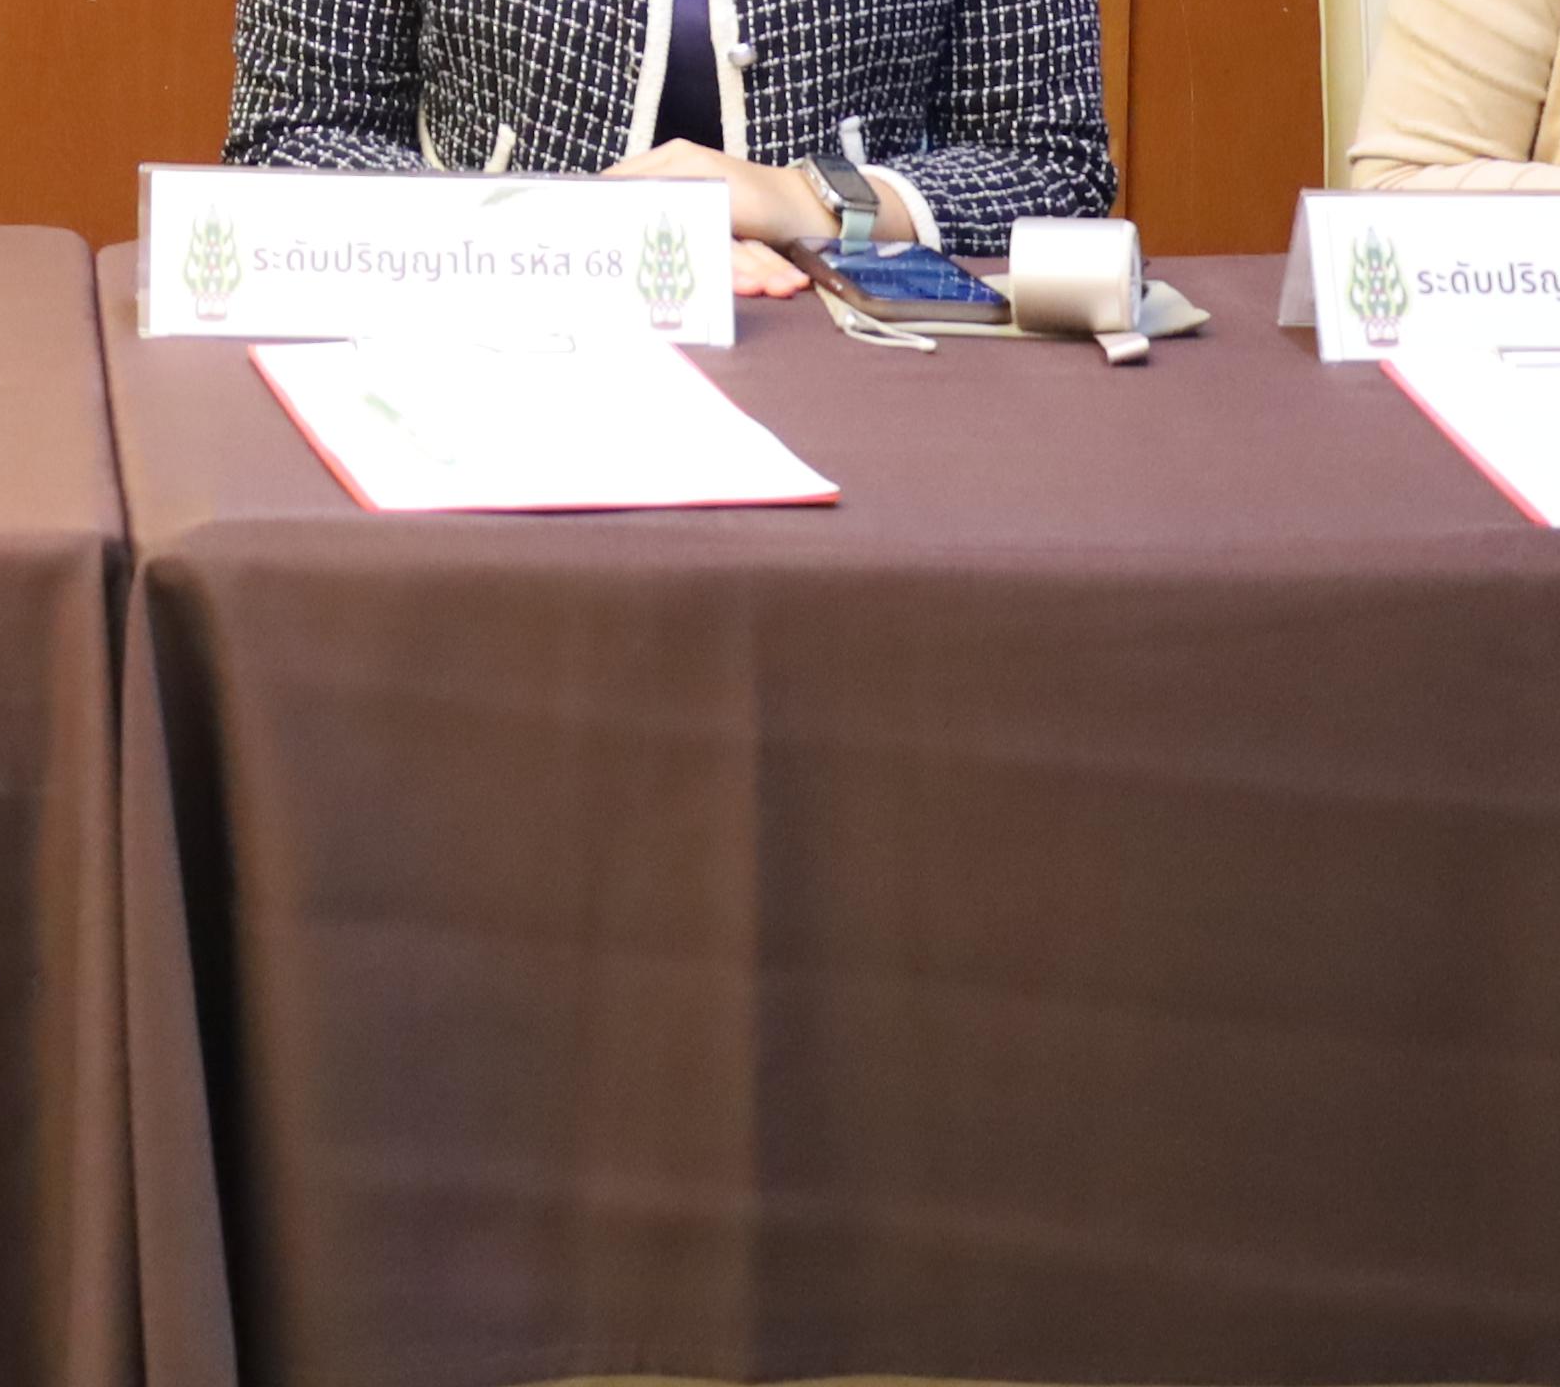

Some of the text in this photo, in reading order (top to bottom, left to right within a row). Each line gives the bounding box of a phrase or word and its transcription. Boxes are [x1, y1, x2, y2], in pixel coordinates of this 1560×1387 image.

[252, 238, 624, 280] ระดับปริญญาโท รหัส 68
